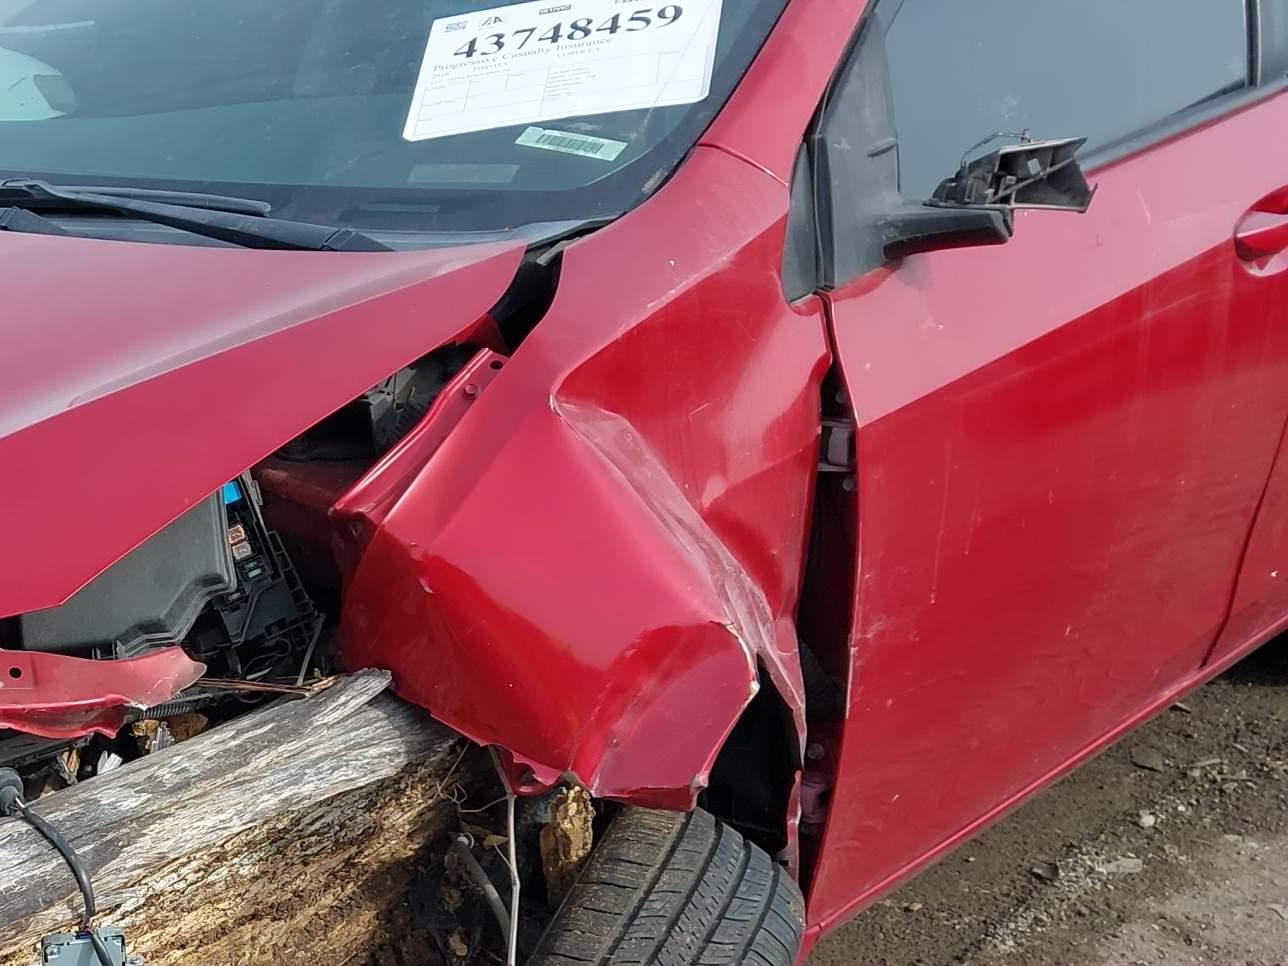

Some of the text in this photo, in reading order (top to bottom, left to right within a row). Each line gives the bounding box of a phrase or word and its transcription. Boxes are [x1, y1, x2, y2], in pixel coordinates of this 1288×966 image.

[453, 4, 683, 58] 43748459
[432, 38, 613, 72] Progressive Casualty Insurance
